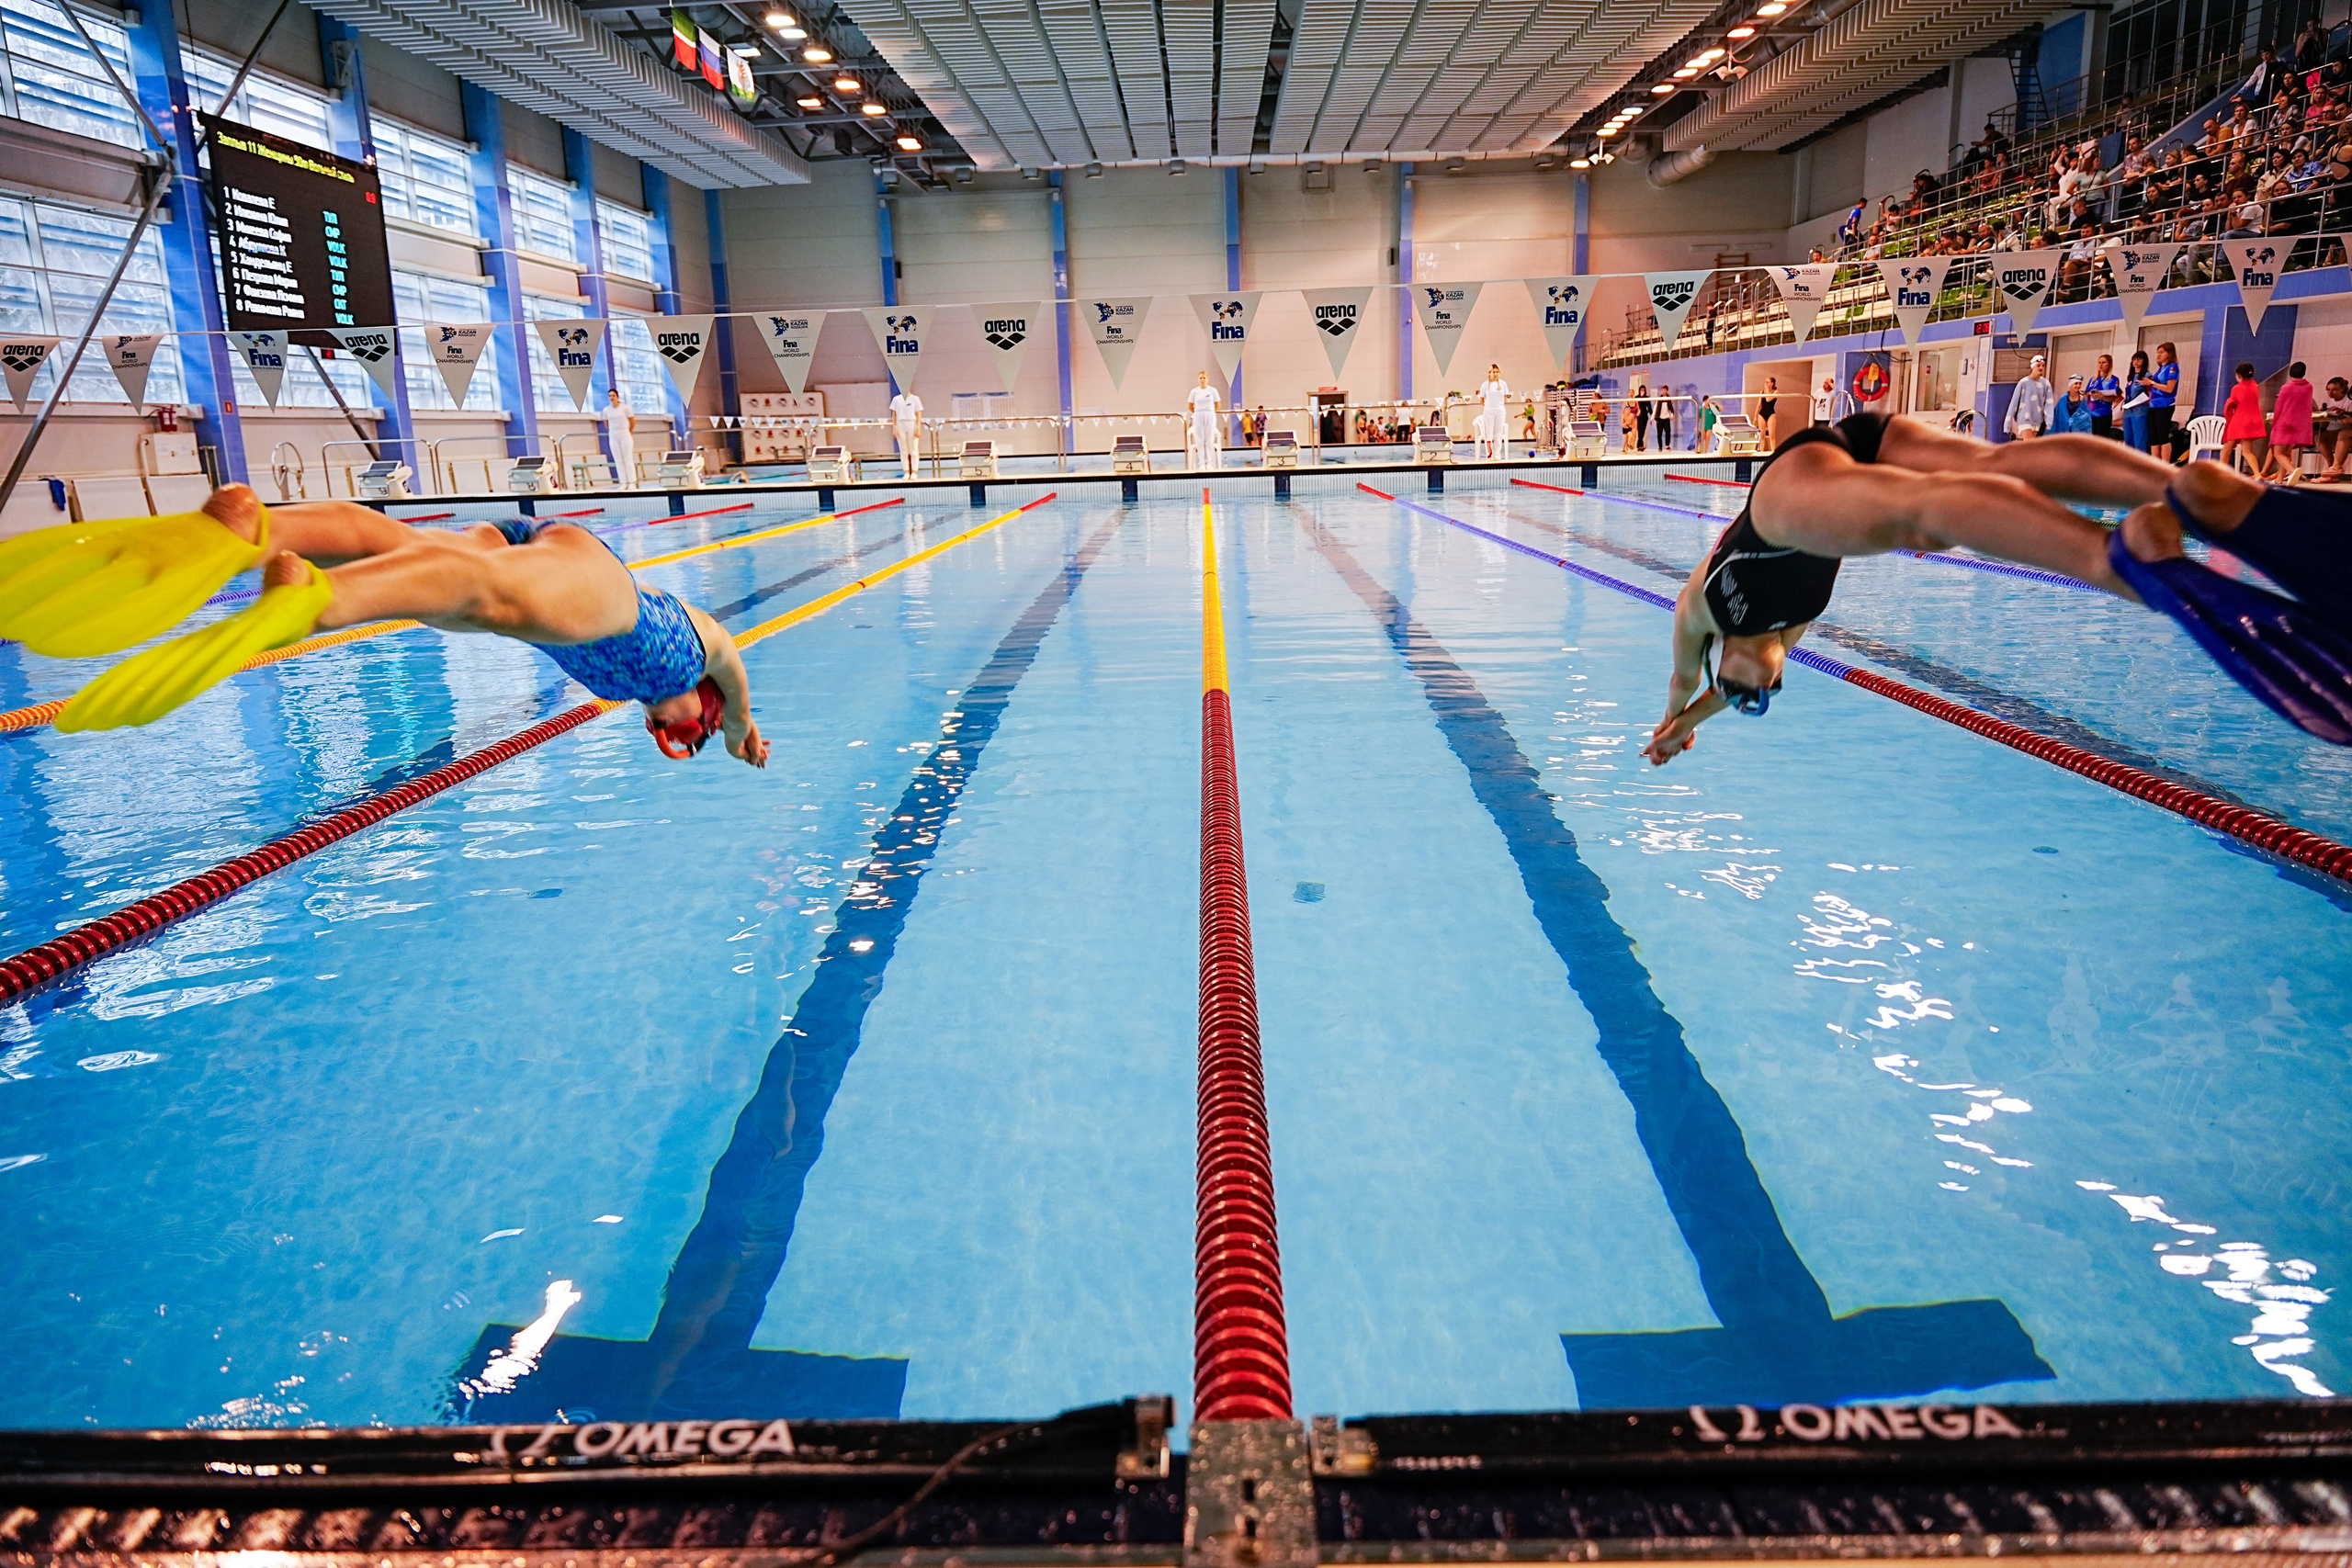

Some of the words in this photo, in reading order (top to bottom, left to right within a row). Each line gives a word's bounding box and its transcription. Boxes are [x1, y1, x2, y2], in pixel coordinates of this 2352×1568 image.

[223, 186, 230, 198] 1
[225, 202, 233, 215] 2
[227, 218, 234, 231] 3
[229, 234, 236, 247] 4
[231, 251, 238, 263] 5
[232, 266, 240, 279] 6
[2002, 268, 2045, 283] arena
[2131, 275, 2144, 283] Fina
[2243, 268, 2273, 287] Fina
[234, 283, 241, 295] 7
[1654, 281, 1694, 296] arena
[1898, 288, 1930, 305] Fina
[235, 299, 243, 311] 8
[1316, 304, 1356, 319] arena
[1545, 306, 1577, 324] Fina
[985, 319, 1025, 333] arena
[1212, 321, 1244, 339] Fina
[345, 333, 388, 348] arena
[658, 333, 700, 345] arena
[887, 335, 918, 353] Fina
[3, 344, 44, 356] arena
[248, 348, 282, 367] Fina
[559, 348, 591, 366] Fina
[1430, 452, 1437, 460] 2
[1584, 448, 1589, 457] 1
[1125, 462, 1133, 470] 4
[1277, 456, 1284, 466] 3
[975, 468, 982, 476] 5
[1780, 1404, 2022, 1441] OMEGA
[574, 1419, 796, 1458] OMEGA
